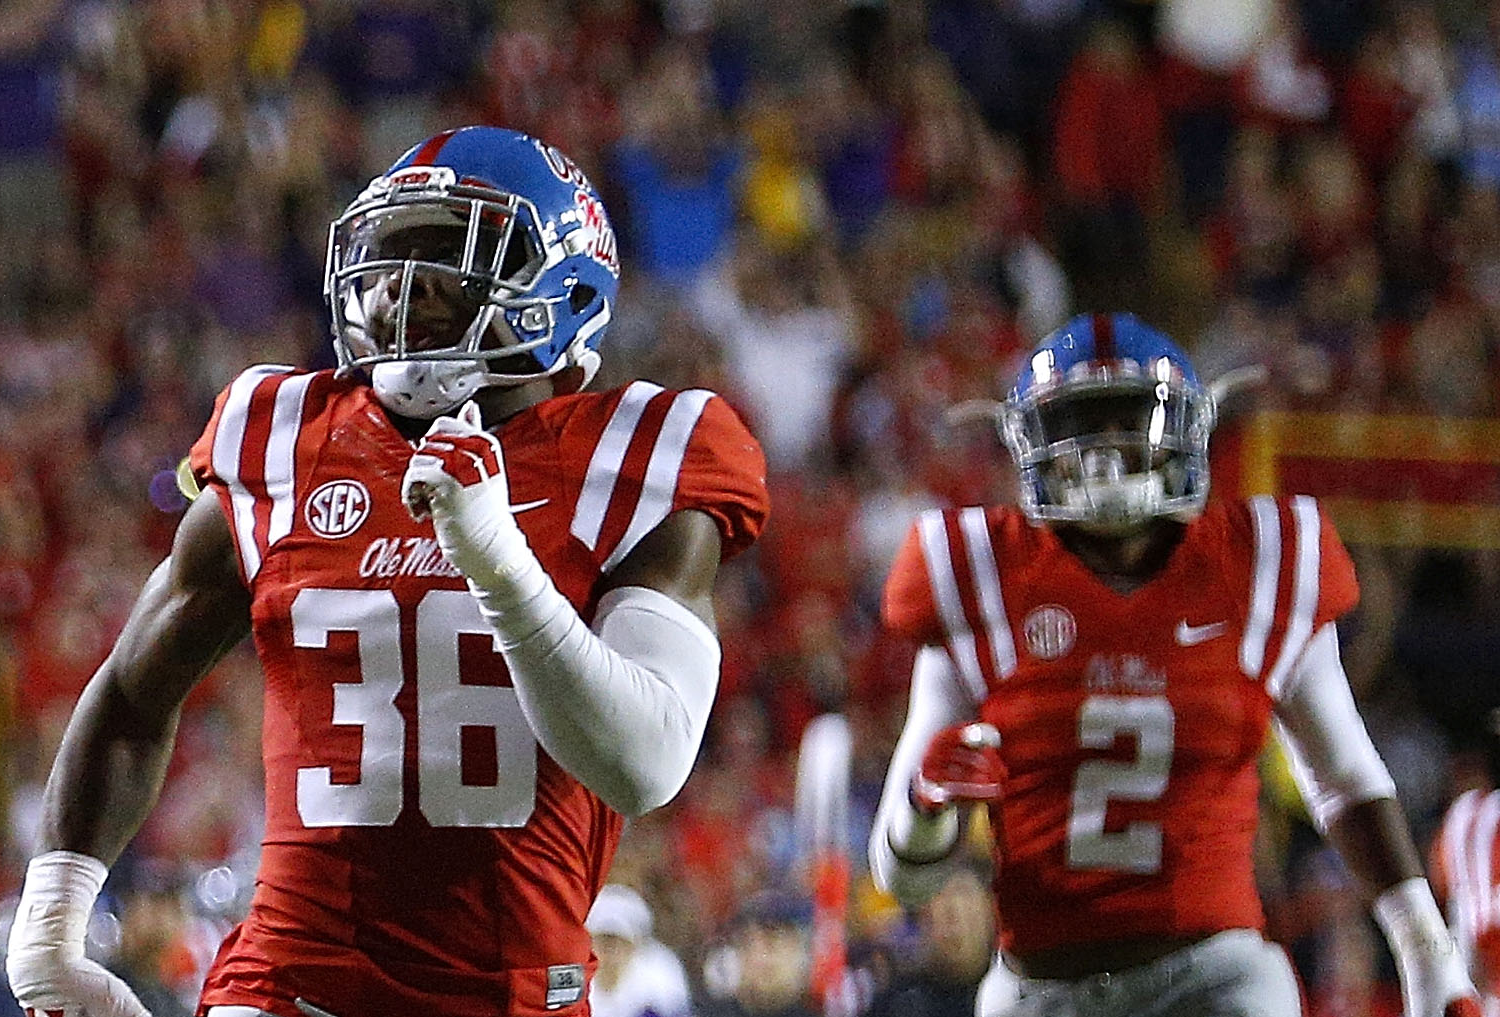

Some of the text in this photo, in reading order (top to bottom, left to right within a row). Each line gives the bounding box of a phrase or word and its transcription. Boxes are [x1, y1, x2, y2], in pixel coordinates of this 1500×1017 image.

[311, 485, 365, 534] SEC
[358, 537, 402, 578] Ole
[291, 588, 538, 828] 36
[1065, 693, 1176, 874] 2
